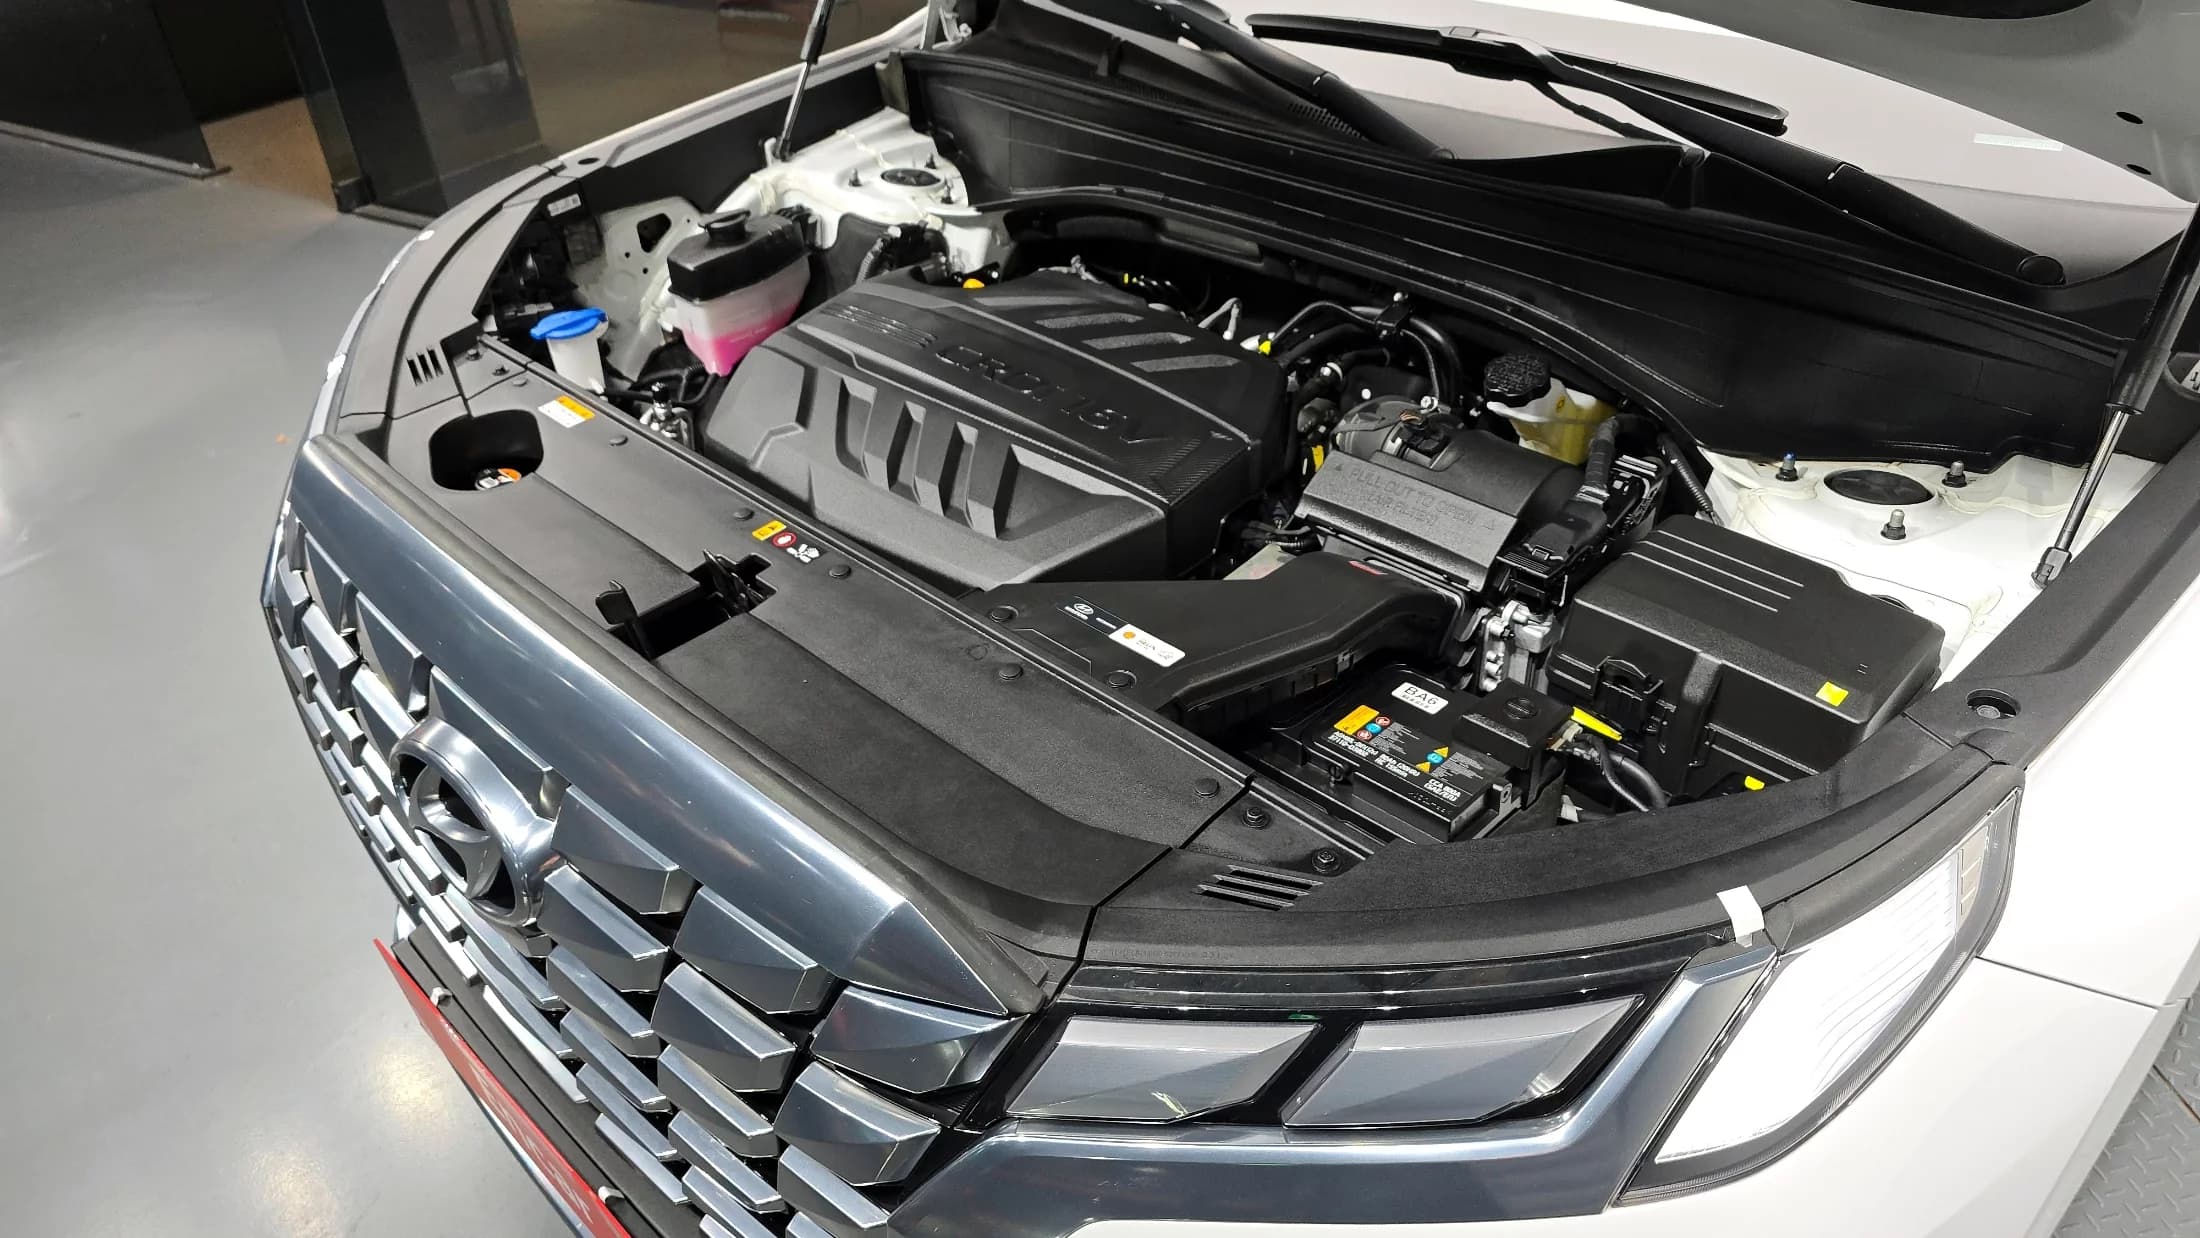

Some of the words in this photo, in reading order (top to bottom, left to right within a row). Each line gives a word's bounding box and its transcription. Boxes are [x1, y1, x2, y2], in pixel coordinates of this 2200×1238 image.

[1351, 471, 1382, 489] PULL
[1383, 481, 1417, 497] OUT
[1416, 491, 1435, 508] TO
[1436, 501, 1476, 525] OPEN
[1404, 686, 1439, 705] BA6
